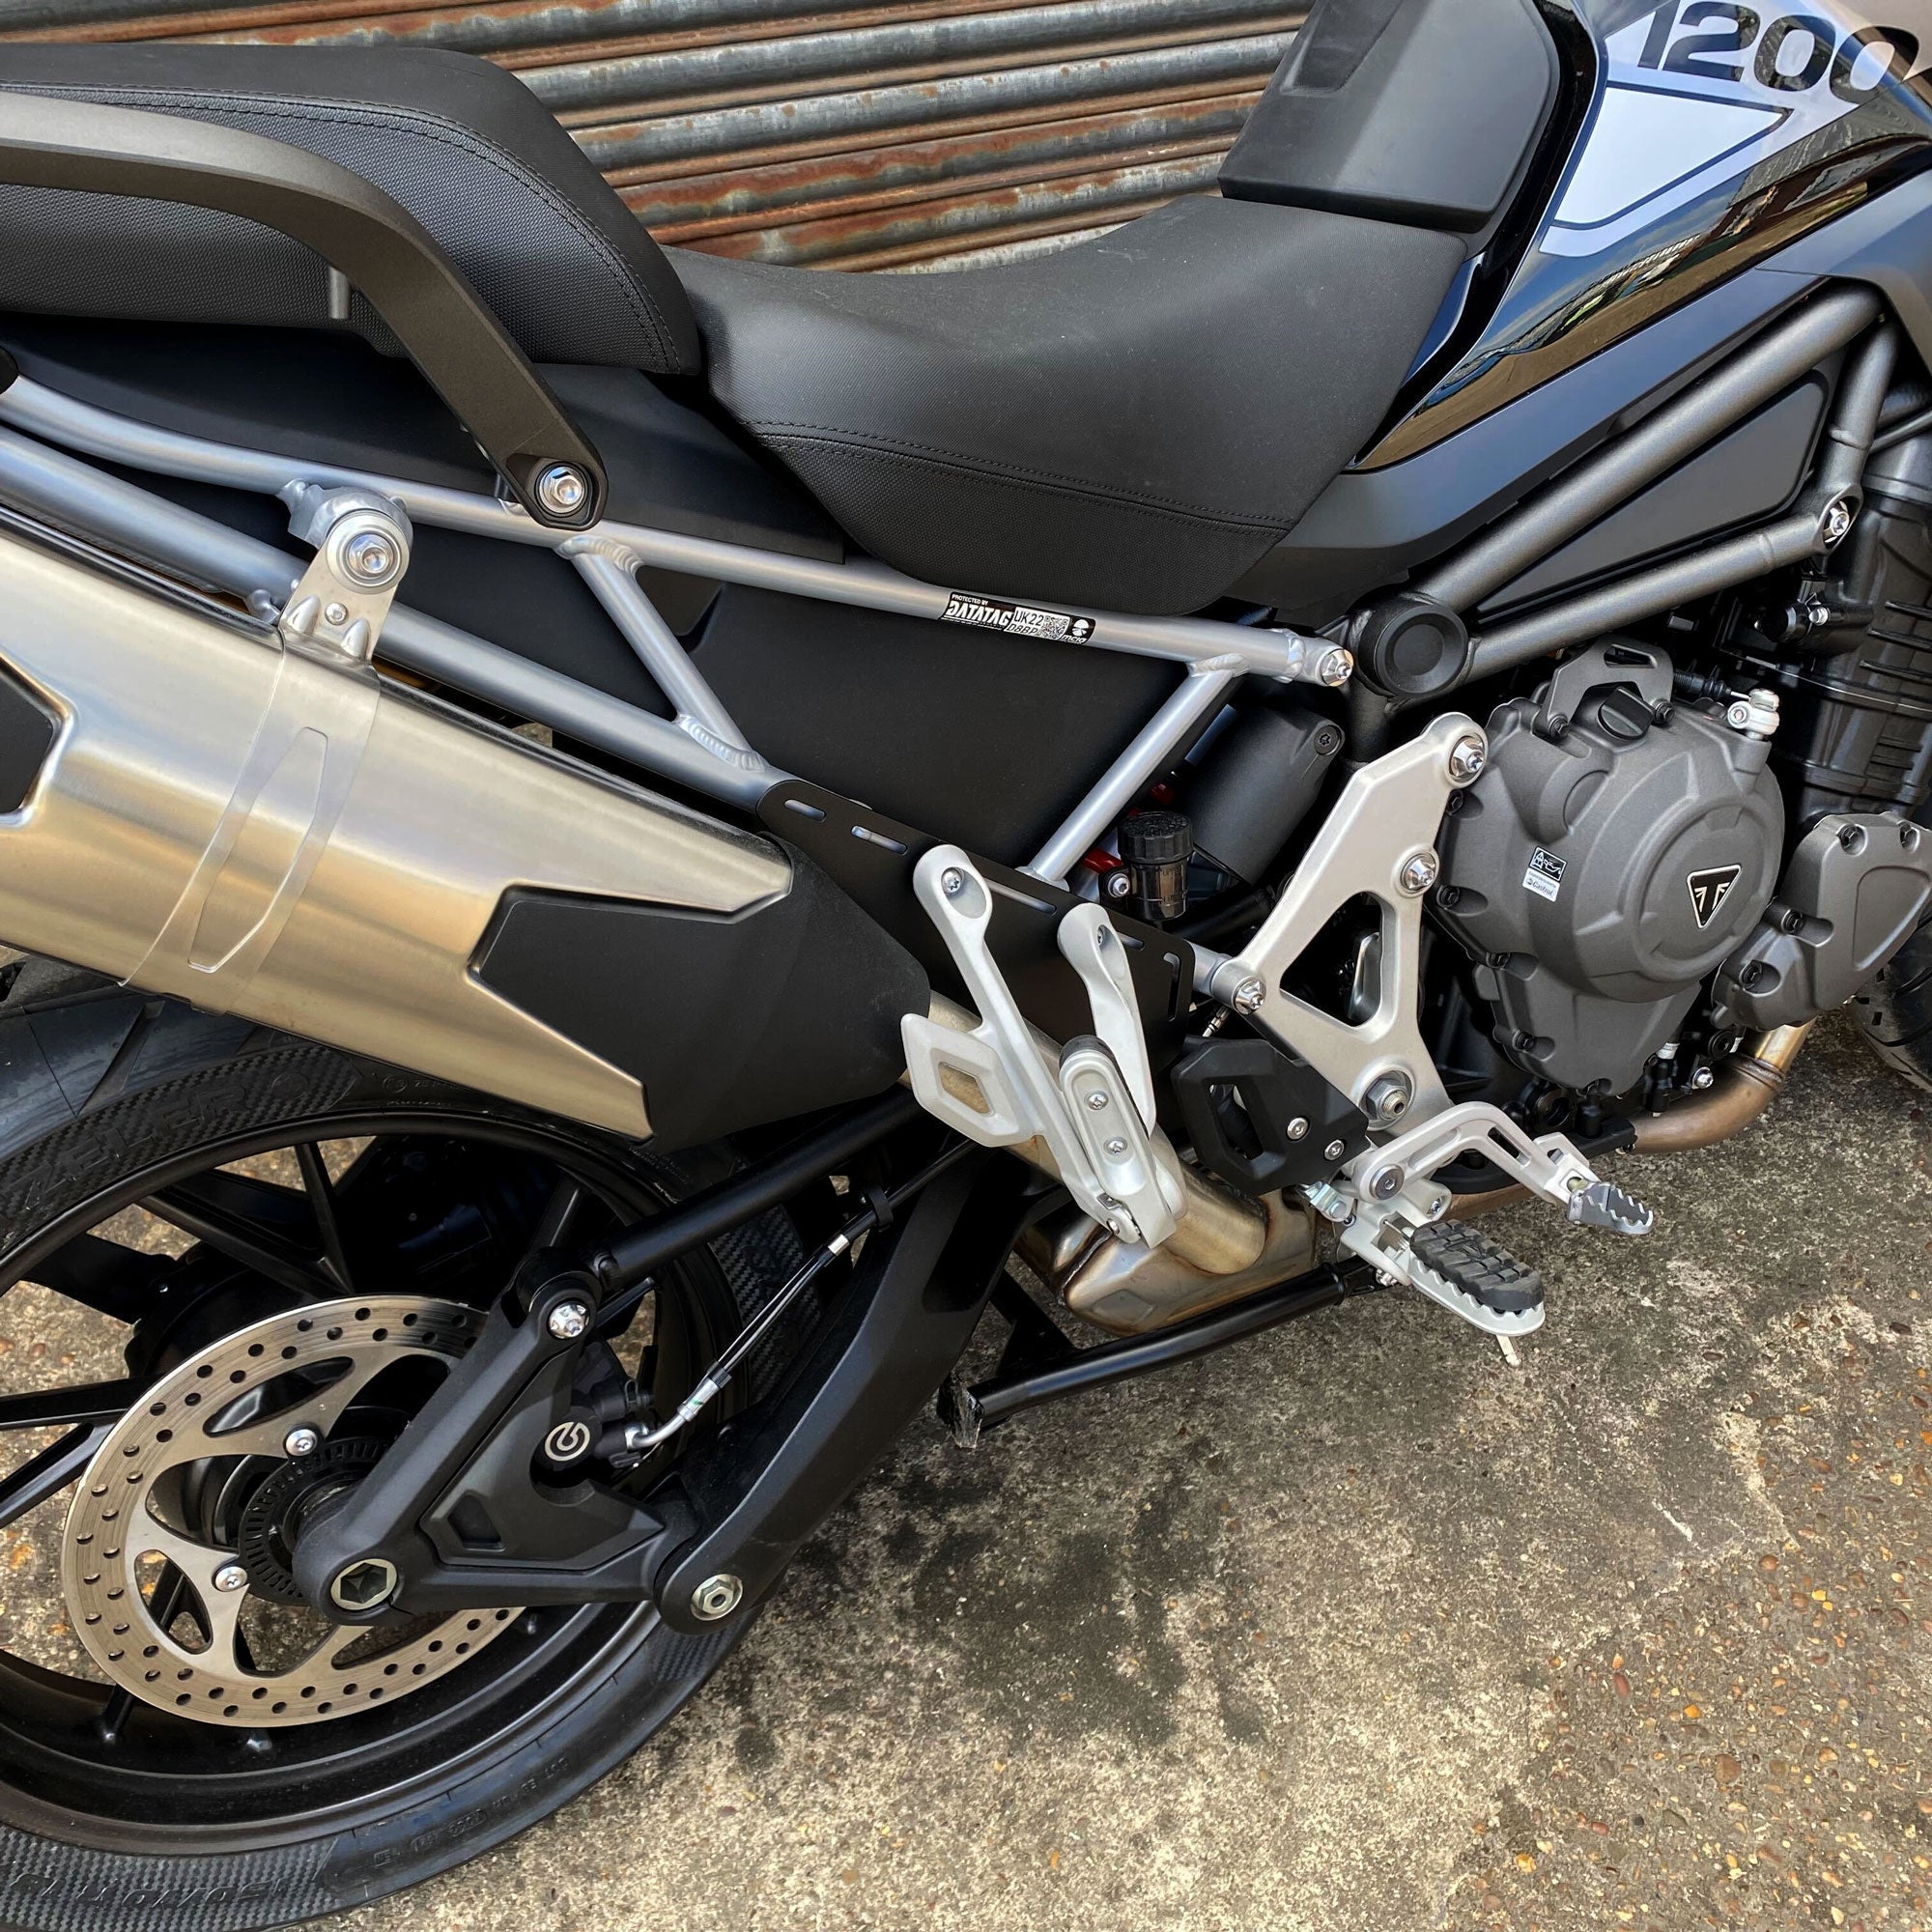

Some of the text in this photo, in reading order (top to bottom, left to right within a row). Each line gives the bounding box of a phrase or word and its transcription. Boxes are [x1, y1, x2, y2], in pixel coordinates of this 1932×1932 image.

[1637, 0, 1920, 105] 1200
[952, 593, 981, 605] PROTECTED
[945, 600, 1013, 627] DATATAG
[1013, 610, 1045, 627] UK22
